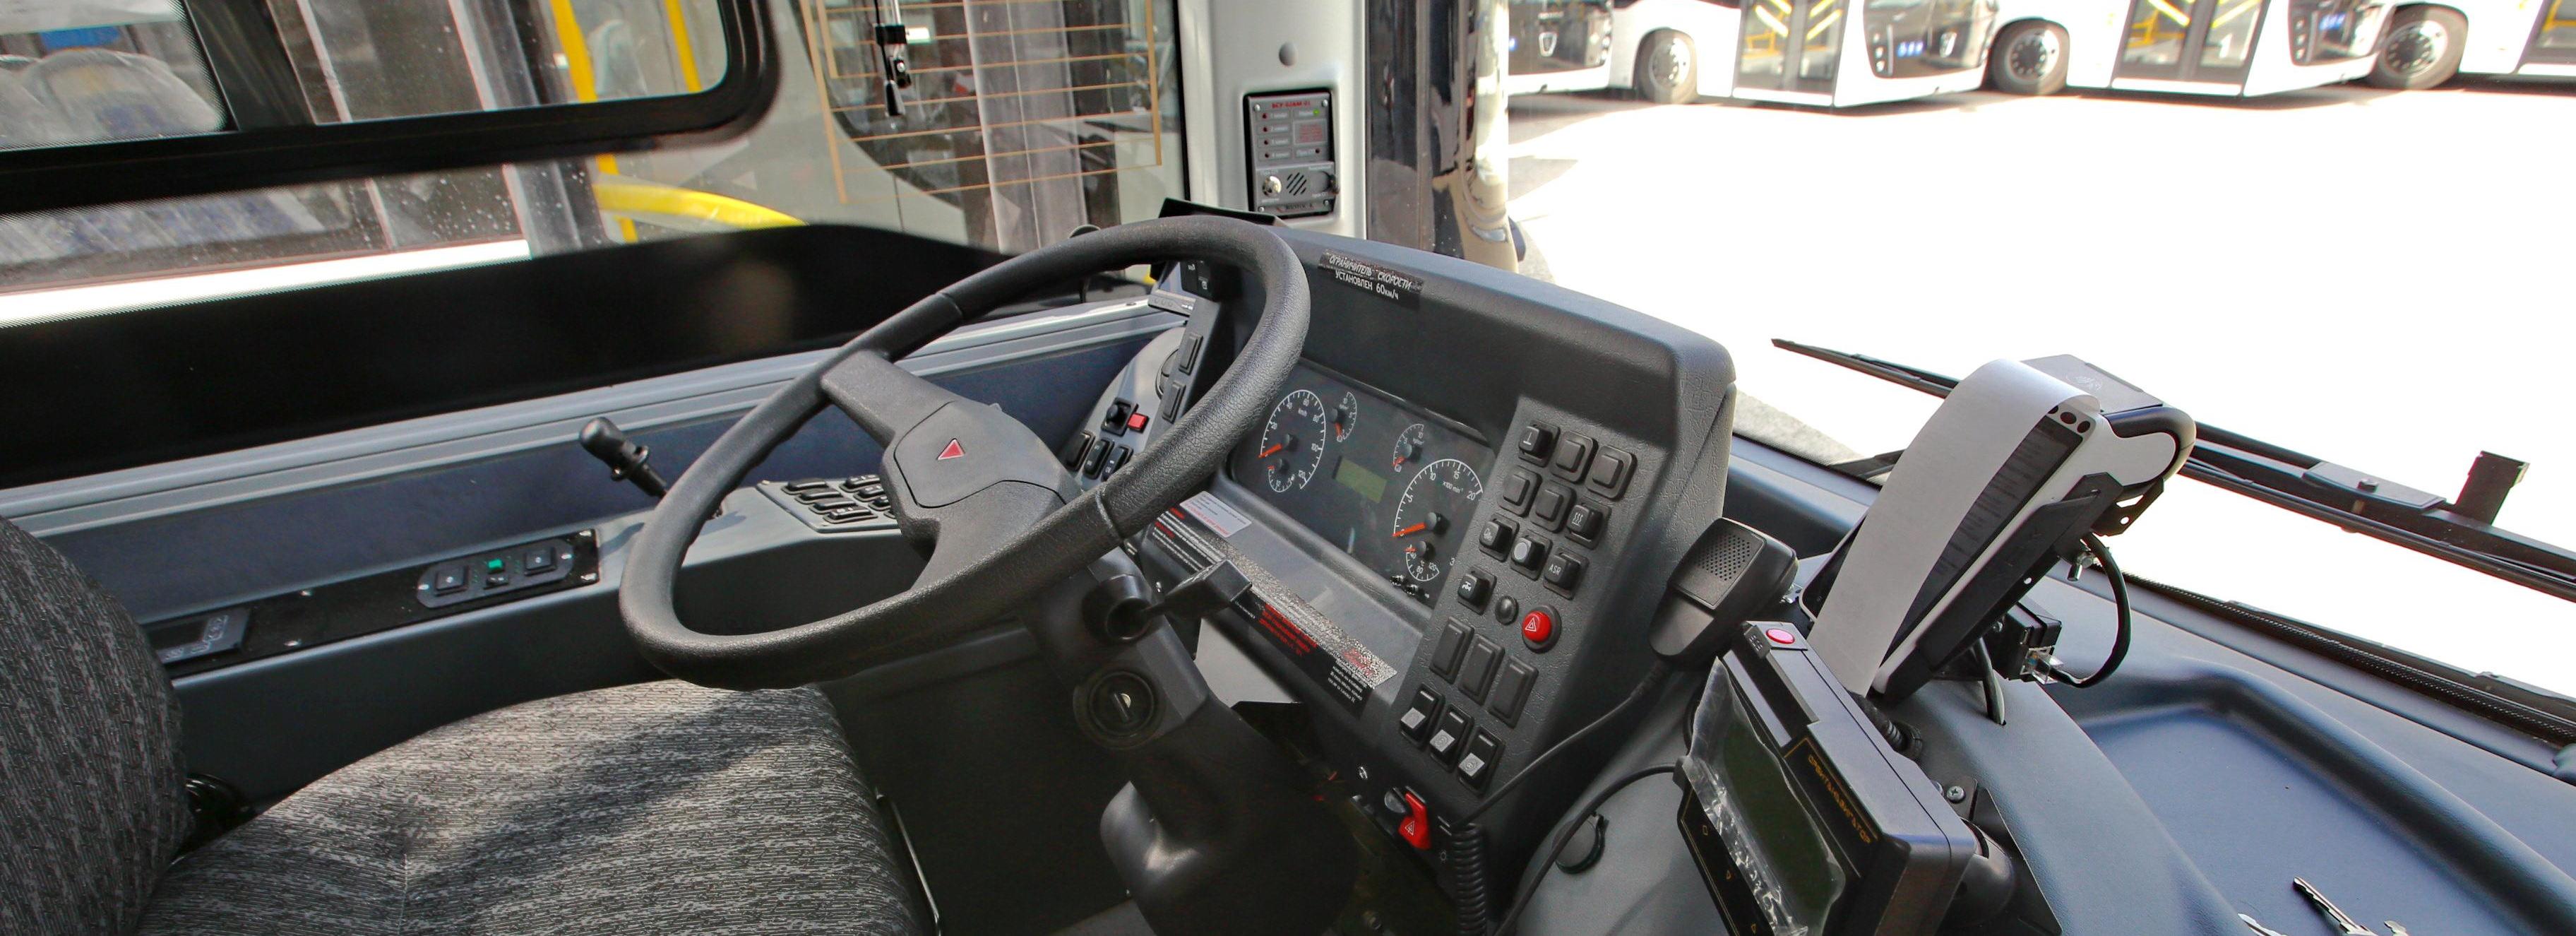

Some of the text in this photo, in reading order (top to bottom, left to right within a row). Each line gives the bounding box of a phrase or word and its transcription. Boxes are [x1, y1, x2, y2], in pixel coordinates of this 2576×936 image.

[1329, 254, 1412, 290] ОГРАНИЧИТЕЛЬ СКОРОСТИ
[1335, 270, 1373, 291] УСТАНОВЛЕН
[1453, 470, 1460, 479] 15
[1467, 491, 1475, 500] 20
[1417, 565, 1423, 574] 80
[1548, 564, 1561, 576] ASR
